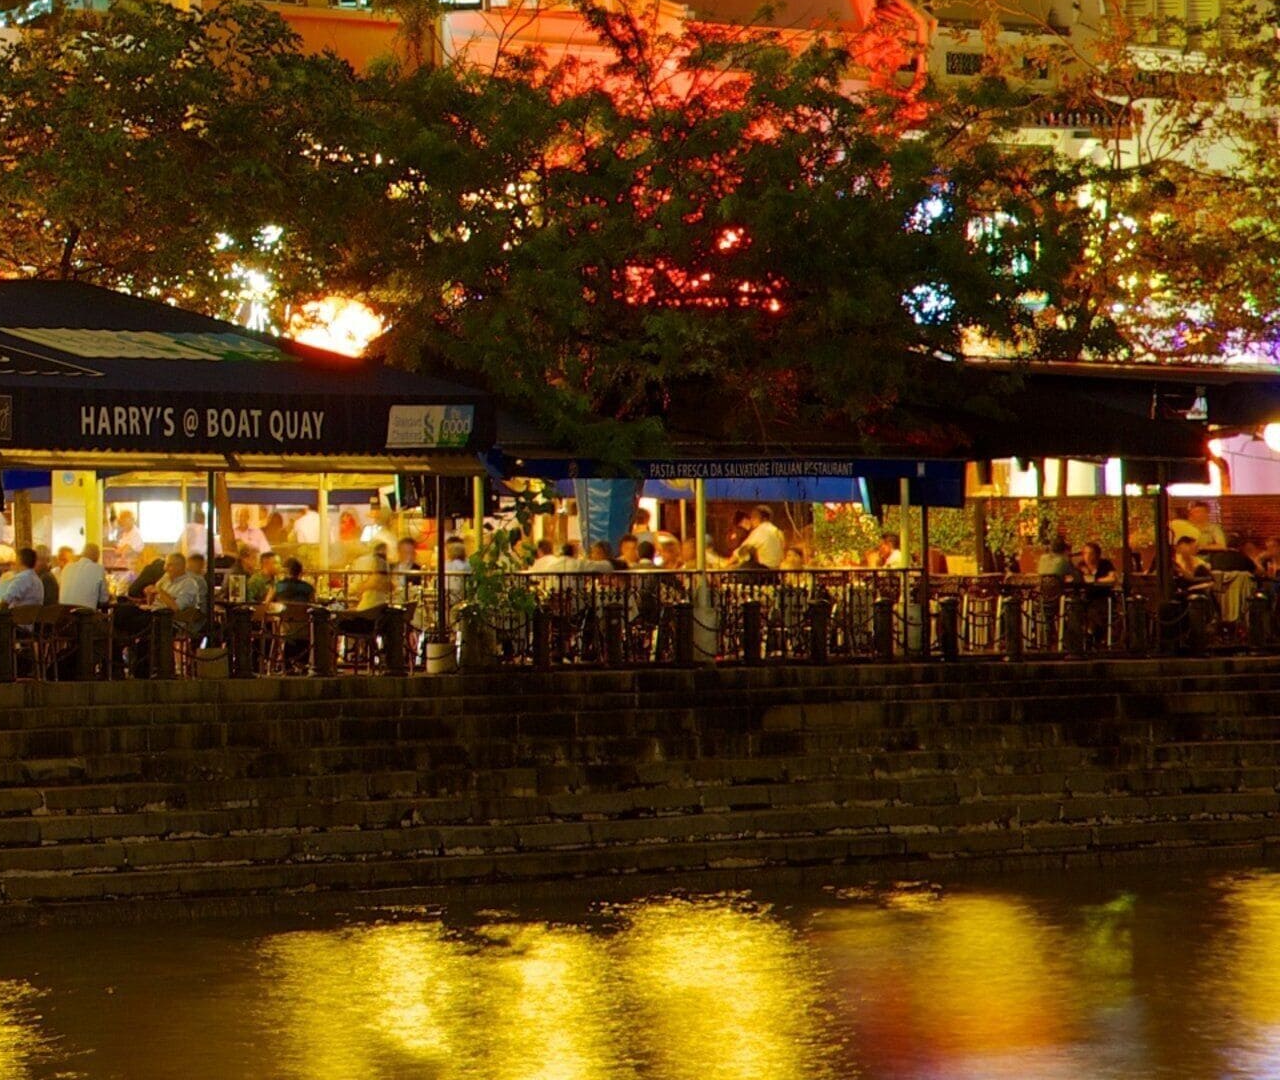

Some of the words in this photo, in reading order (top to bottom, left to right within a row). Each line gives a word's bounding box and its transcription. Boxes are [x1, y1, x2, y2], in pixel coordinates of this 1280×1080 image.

[80, 405, 175, 437] HARRY'S
[183, 407, 200, 438] @
[206, 407, 263, 439] BOAT
[268, 409, 325, 443] QUAY
[649, 462, 676, 478] PASTA
[676, 462, 709, 477] FRESCA
[710, 462, 723, 477] DA
[724, 462, 770, 477] SALVATORE
[771, 461, 802, 476] ITALIAN
